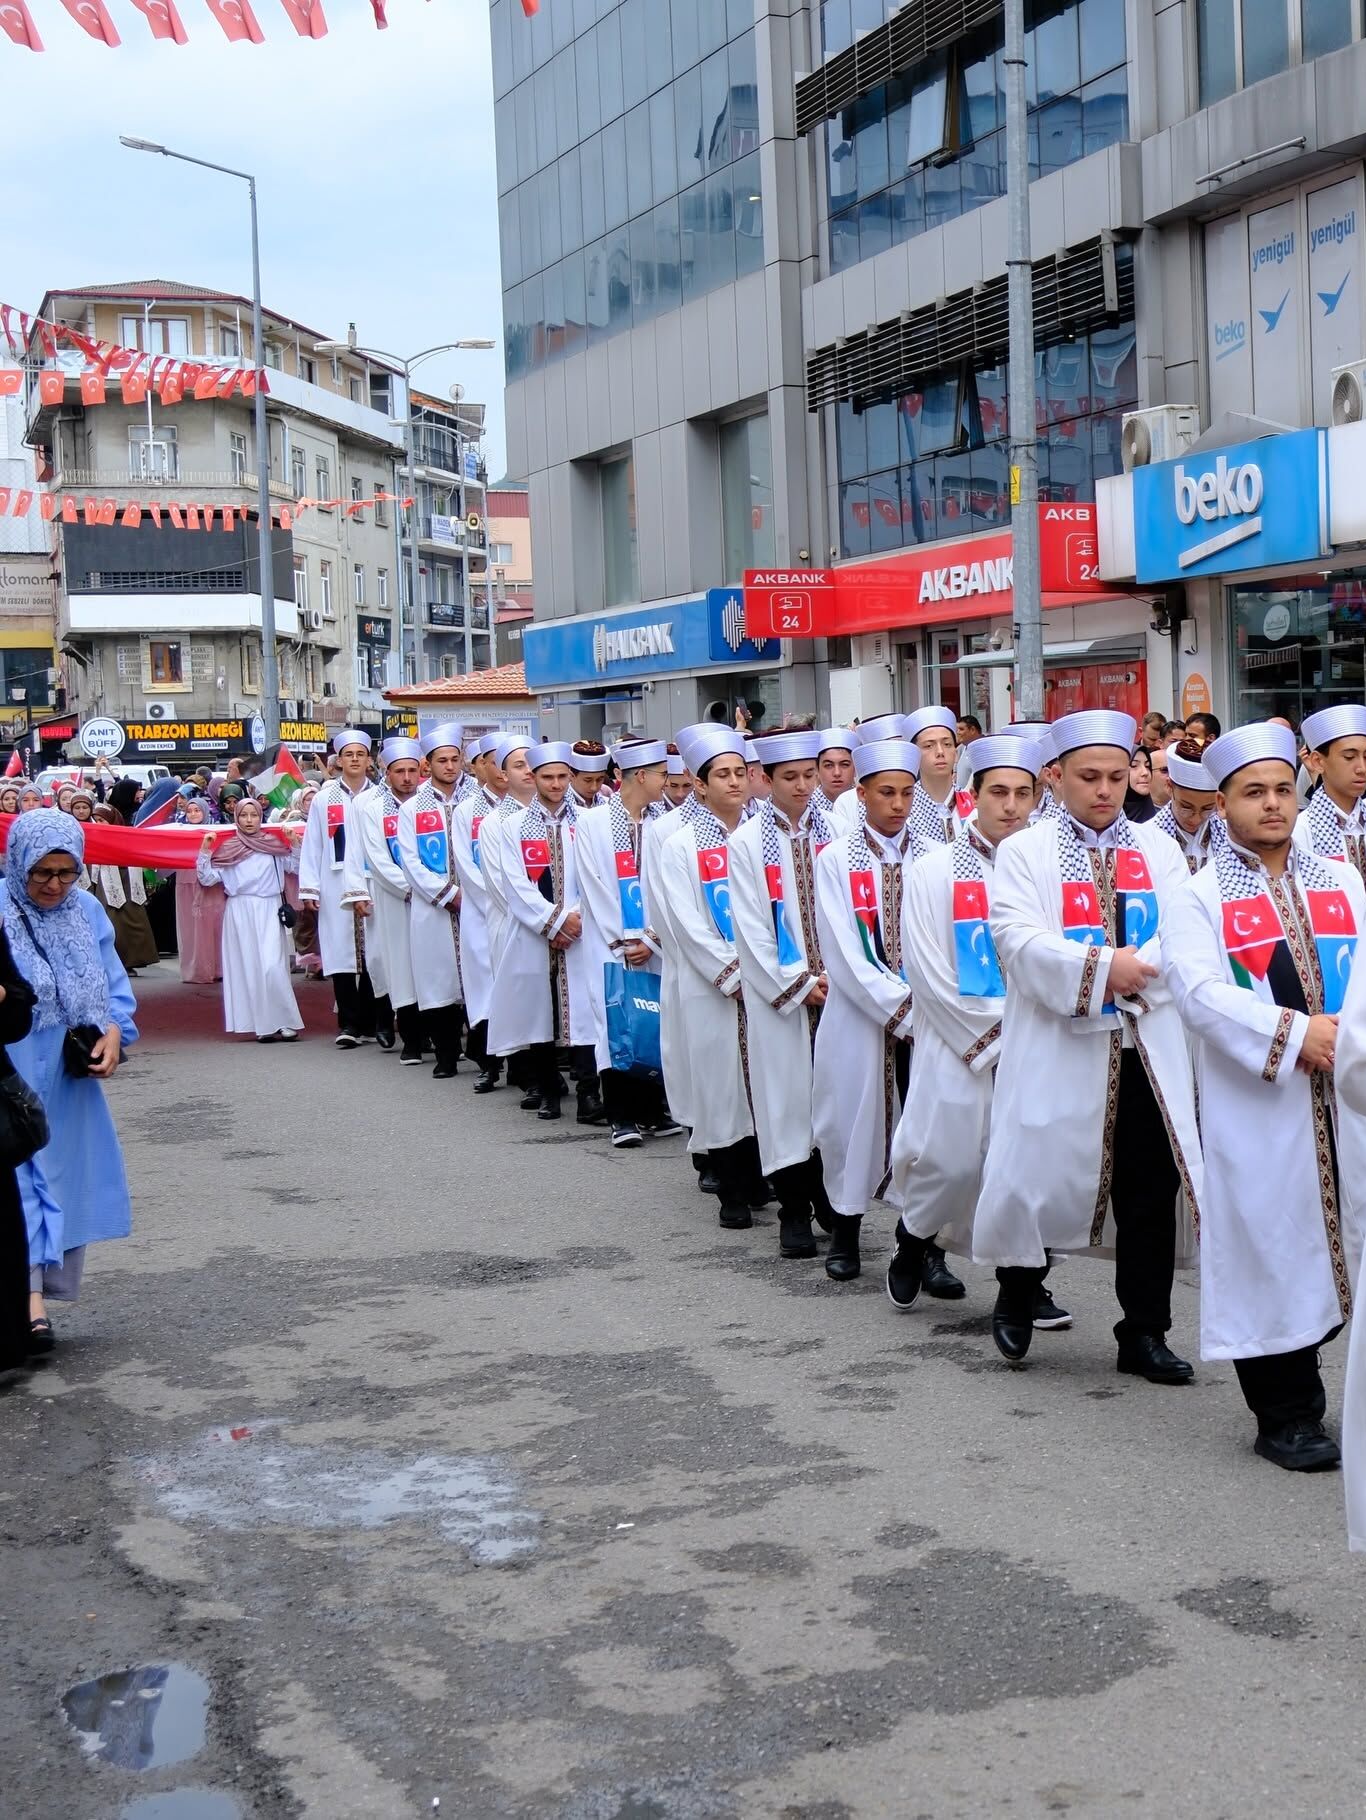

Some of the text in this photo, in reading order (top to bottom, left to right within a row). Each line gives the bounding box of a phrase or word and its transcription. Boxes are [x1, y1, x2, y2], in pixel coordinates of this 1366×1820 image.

[1310, 211, 1356, 253] yenigül
[1253, 232, 1294, 273] yenigül
[1214, 319, 1245, 346] beko
[1174, 456, 1264, 525] beko
[1044, 508, 1090, 521] AKB
[753, 573, 826, 584] AKBANK
[918, 554, 1015, 604] AKBANK
[782, 615, 800, 629] 24
[606, 622, 675, 661] HALKBANK
[1058, 677, 1082, 688] AKBANK
[1100, 674, 1125, 685] AKBANK
[88, 728, 116, 736] ANIT
[126, 721, 243, 740] TRABZON EKMEĞİ
[88, 738, 118, 748] BÜFE
[633, 997, 661, 1013] ma
